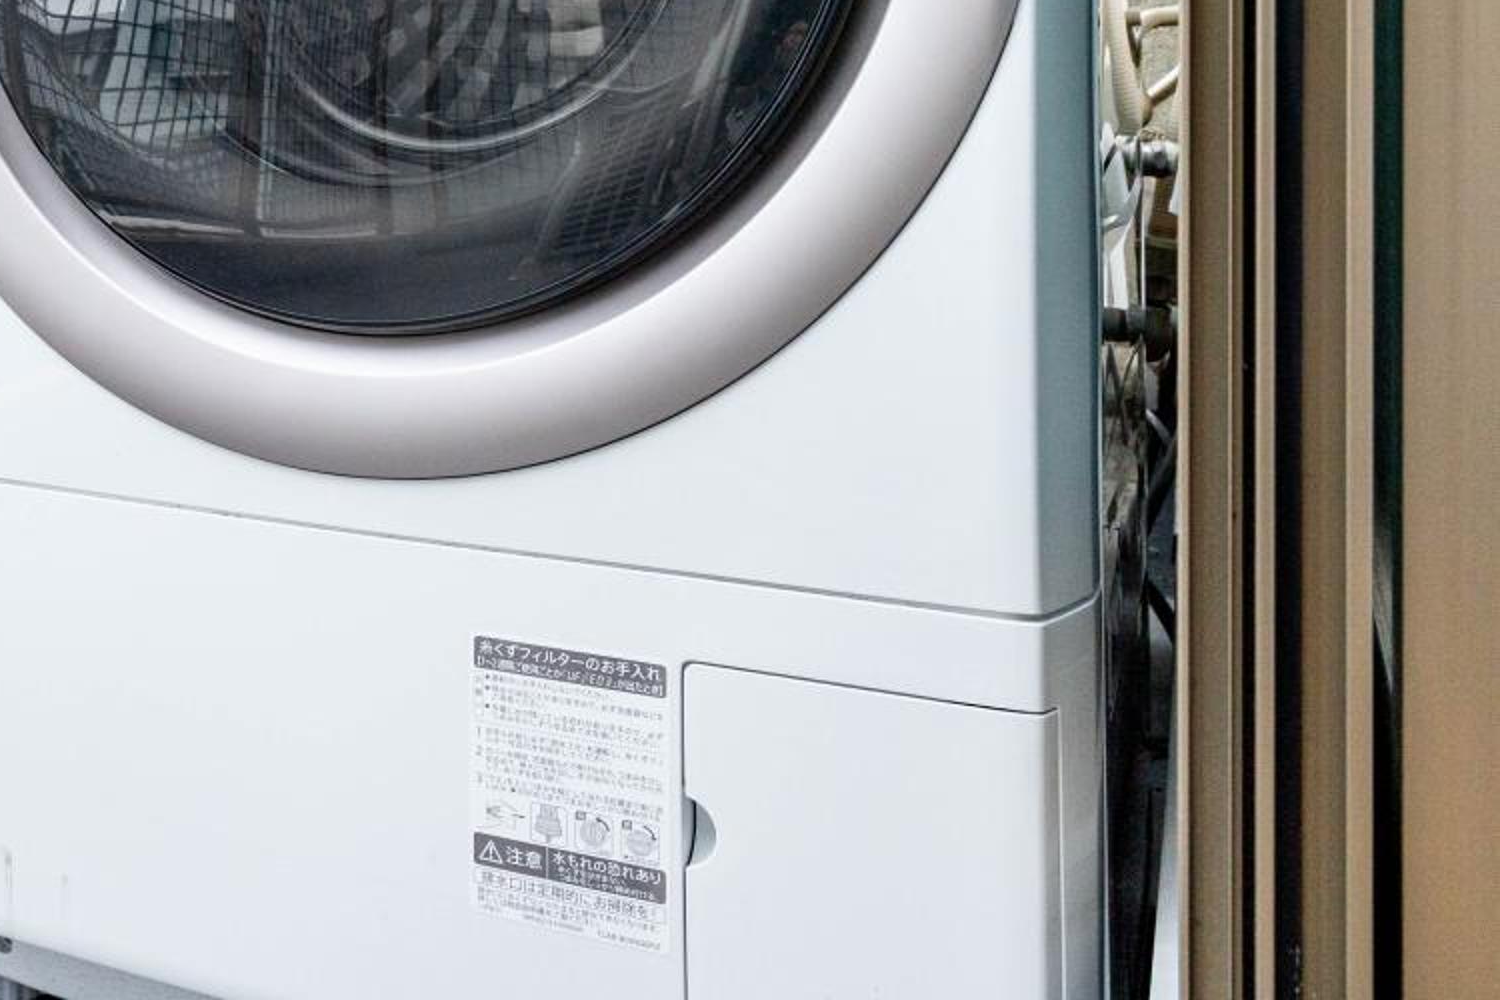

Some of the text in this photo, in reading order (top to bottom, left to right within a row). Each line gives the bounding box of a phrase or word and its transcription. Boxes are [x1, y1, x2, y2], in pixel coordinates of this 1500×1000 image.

[479, 640, 662, 681] 糸くずフィルターのお手入れ
[506, 847, 544, 870] 注意
[552, 851, 662, 884] 水もれの恐れあり
